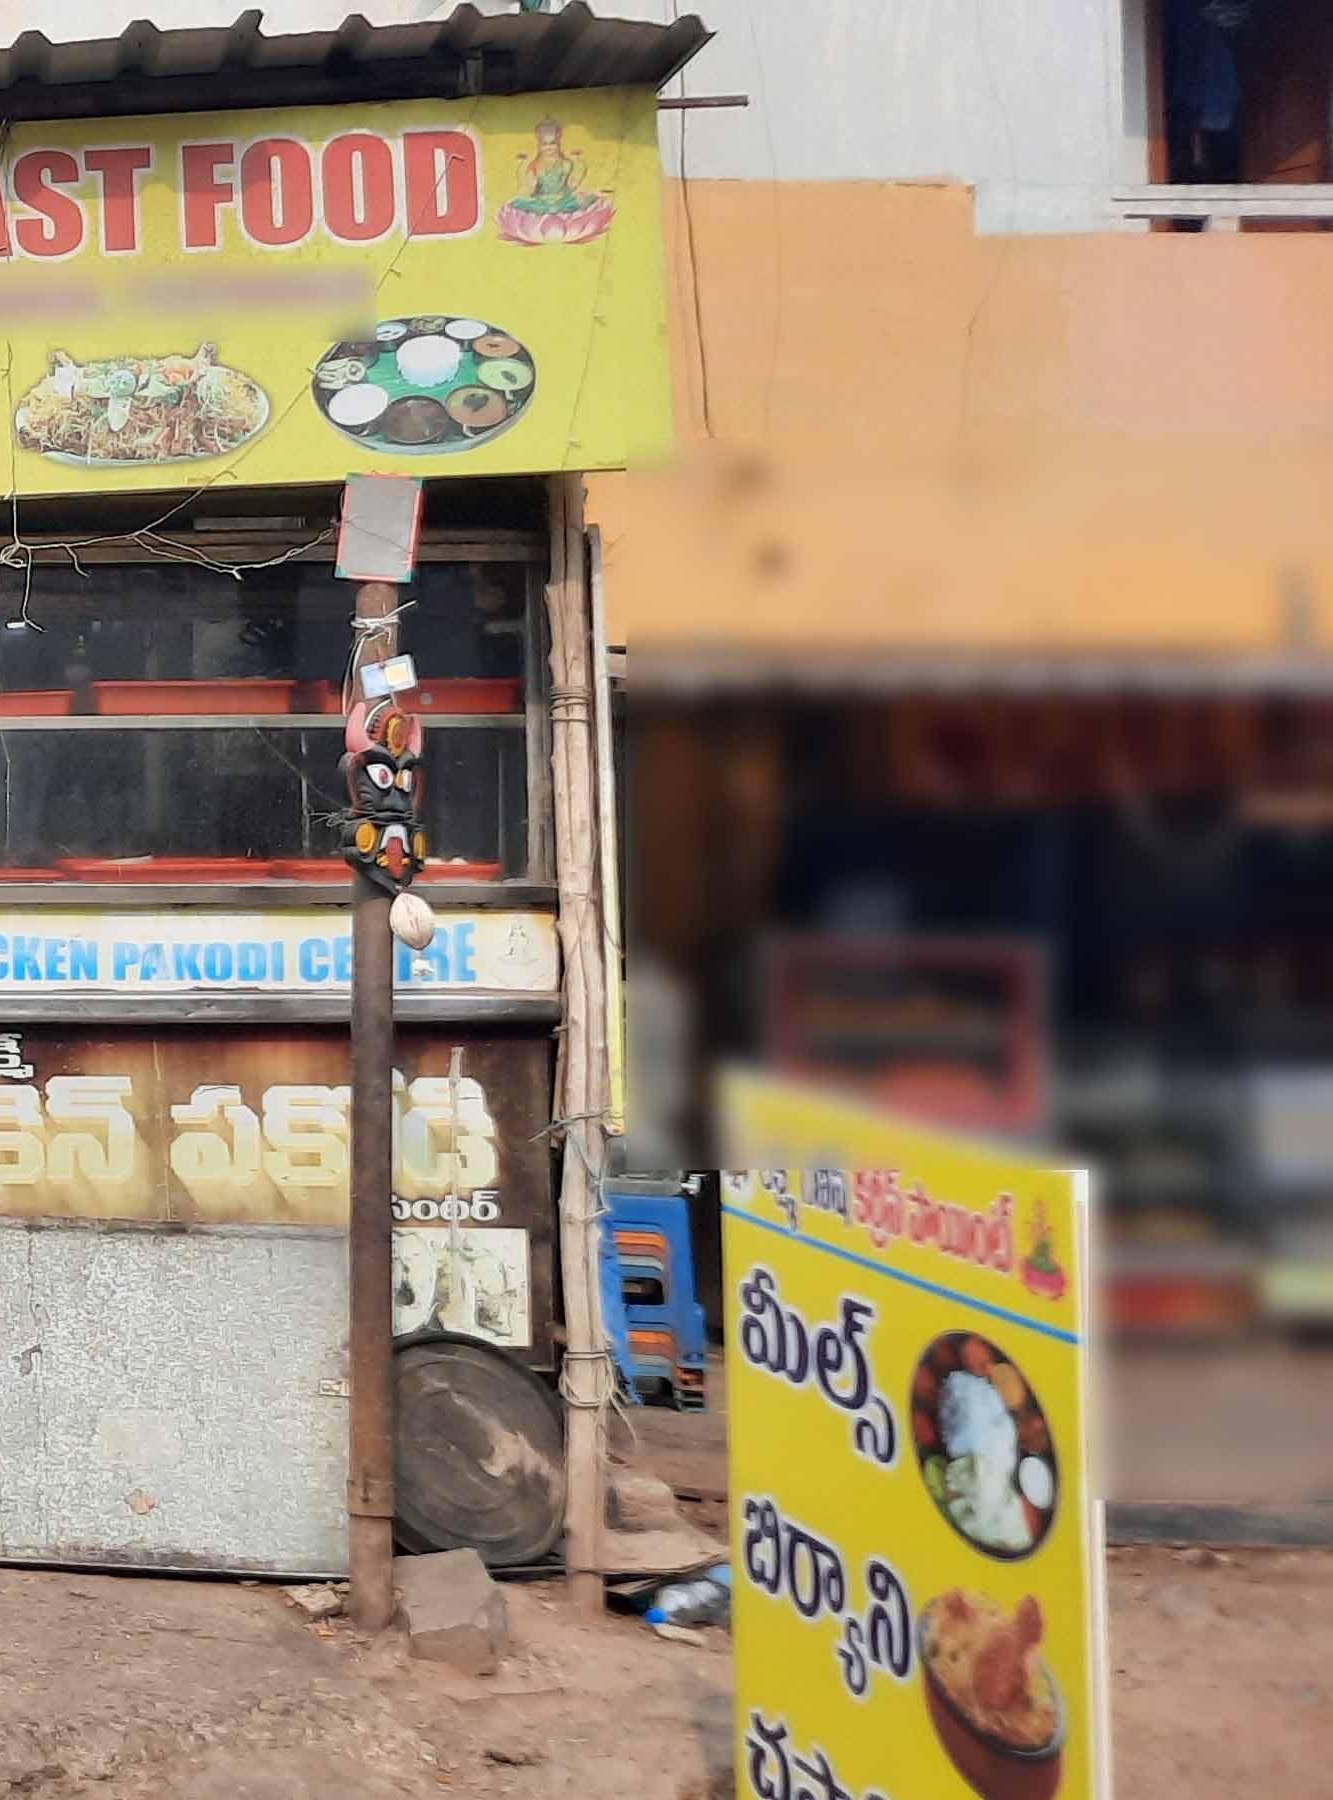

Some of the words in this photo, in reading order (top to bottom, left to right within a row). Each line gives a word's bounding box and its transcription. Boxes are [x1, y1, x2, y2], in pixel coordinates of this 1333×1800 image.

[181, 131, 480, 248] FOOD
[113, 940, 285, 982] PAKODI
[299, 921, 476, 982] CERE
[742, 1268, 895, 1464] మీల్స్
